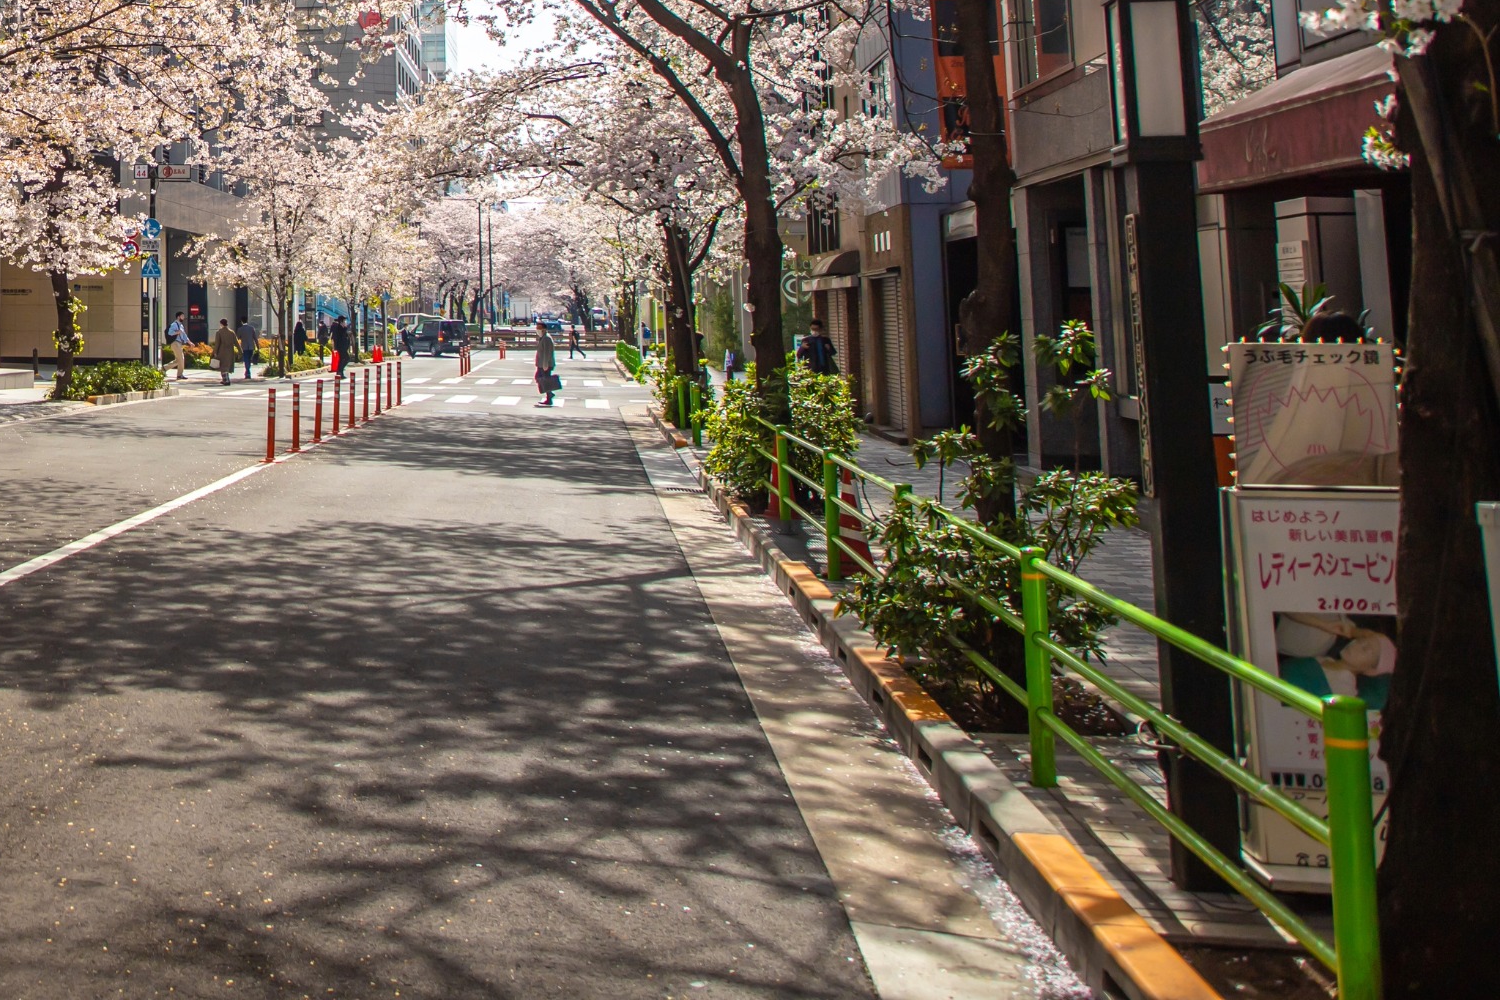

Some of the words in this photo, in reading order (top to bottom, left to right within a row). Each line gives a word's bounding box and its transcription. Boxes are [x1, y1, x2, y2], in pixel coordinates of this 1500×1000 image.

[136, 169, 147, 177] 44
[1243, 349, 1380, 365] うぶ毛チェック鏡
[1288, 529, 1395, 543] 新しい美肌習慣
